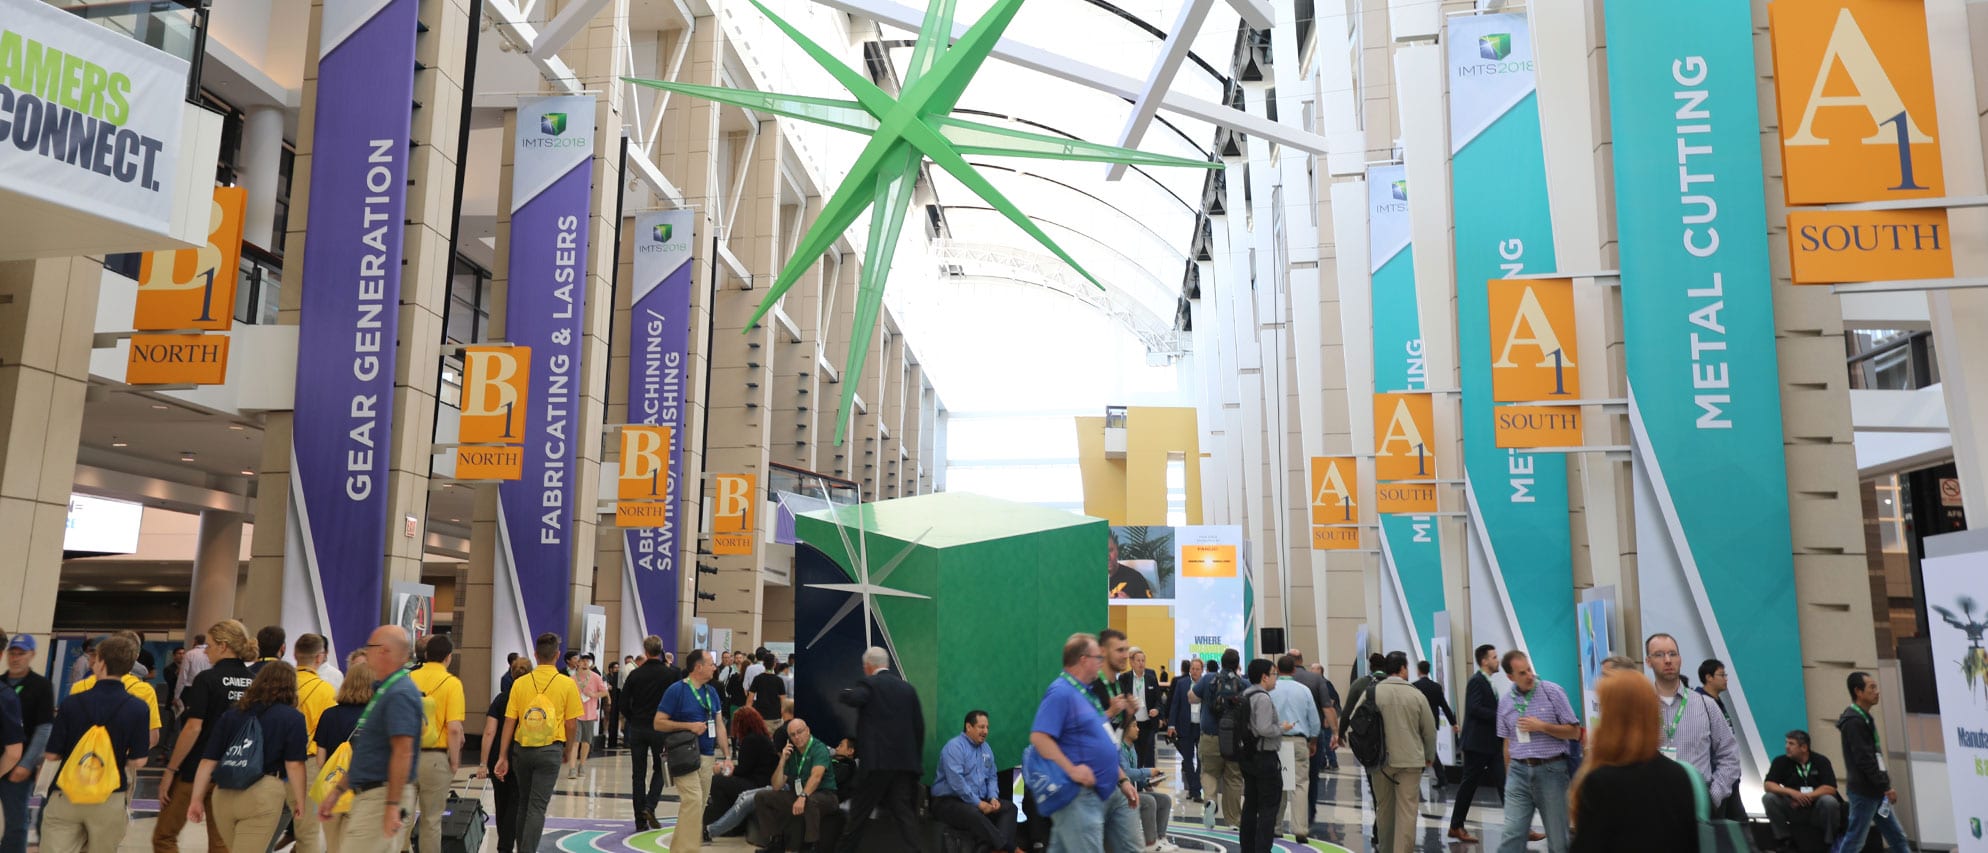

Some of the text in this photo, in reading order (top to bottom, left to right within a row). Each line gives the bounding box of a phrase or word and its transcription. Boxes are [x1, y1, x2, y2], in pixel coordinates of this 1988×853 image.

[0, 29, 131, 127] AMERS
[1458, 60, 1534, 77] IMTS2018
[1784, 8, 1934, 190] A1
[522, 137, 586, 148] IMTS2018
[1375, 203, 1408, 213] IMTS
[639, 243, 687, 253] IMTS2018
[1672, 55, 1732, 429] METAL CUTTING
[1801, 223, 1943, 252] SOUTH
[346, 139, 395, 501] GEAR GENERATION
[1492, 285, 1576, 395] A1
[132, 344, 219, 363] NORTH
[541, 214, 578, 544] FABRICATING & LASERS
[643, 308, 666, 427] ACHINING/
[460, 351, 518, 438] B1
[1499, 413, 1577, 430] SOUTH
[1375, 398, 1433, 476] A1
[459, 452, 518, 466] NORTH
[619, 430, 662, 496] B1
[1312, 460, 1356, 521] A1
[1380, 489, 1433, 501] SOUTH
[619, 505, 662, 517] NORTH
[715, 477, 749, 531] B1
[715, 538, 750, 548] NORTH
[1315, 530, 1356, 541] SOUTH
[1195, 635, 1222, 645] WHERE
[222, 676, 253, 687] CAMER
